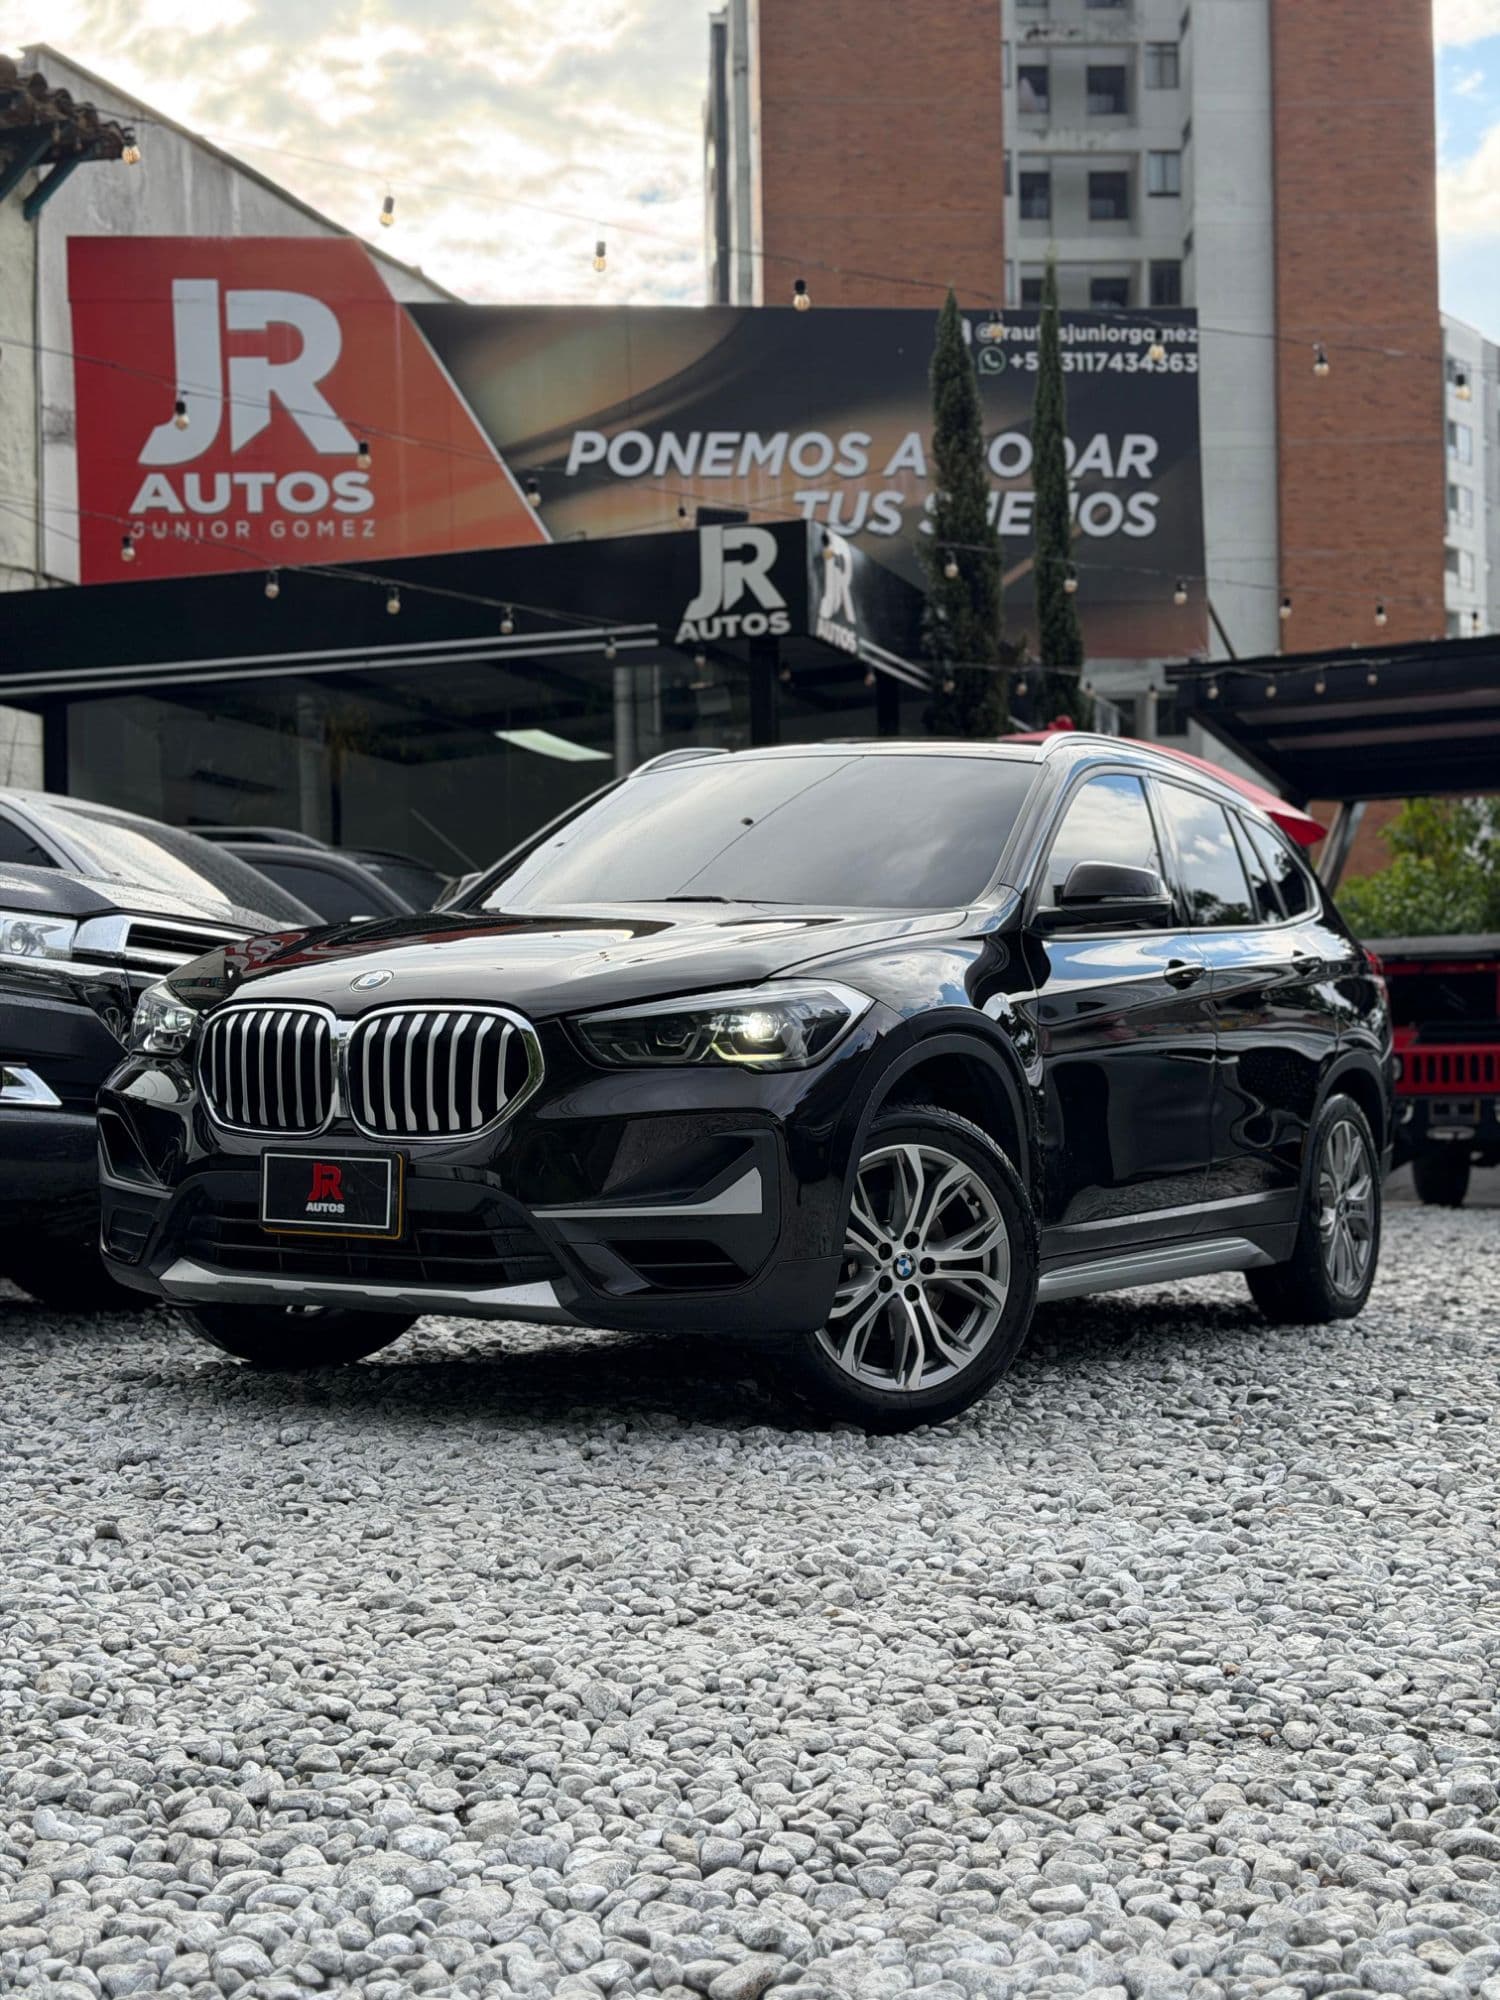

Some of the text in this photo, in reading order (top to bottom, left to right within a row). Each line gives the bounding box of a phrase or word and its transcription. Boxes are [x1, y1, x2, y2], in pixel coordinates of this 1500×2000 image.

[138, 279, 361, 466] JR
[565, 430, 1160, 479] PONEMOS A OAR
[129, 472, 375, 514] AUTOS
[793, 490, 904, 536] TUS
[130, 519, 376, 539] JUNIOR GOMEZ
[683, 525, 788, 621] JR
[674, 611, 792, 644] AUTOS
[815, 618, 857, 653] AUTOS
[307, 1162, 345, 1201] JR
[305, 1202, 345, 1213] AUTOS
